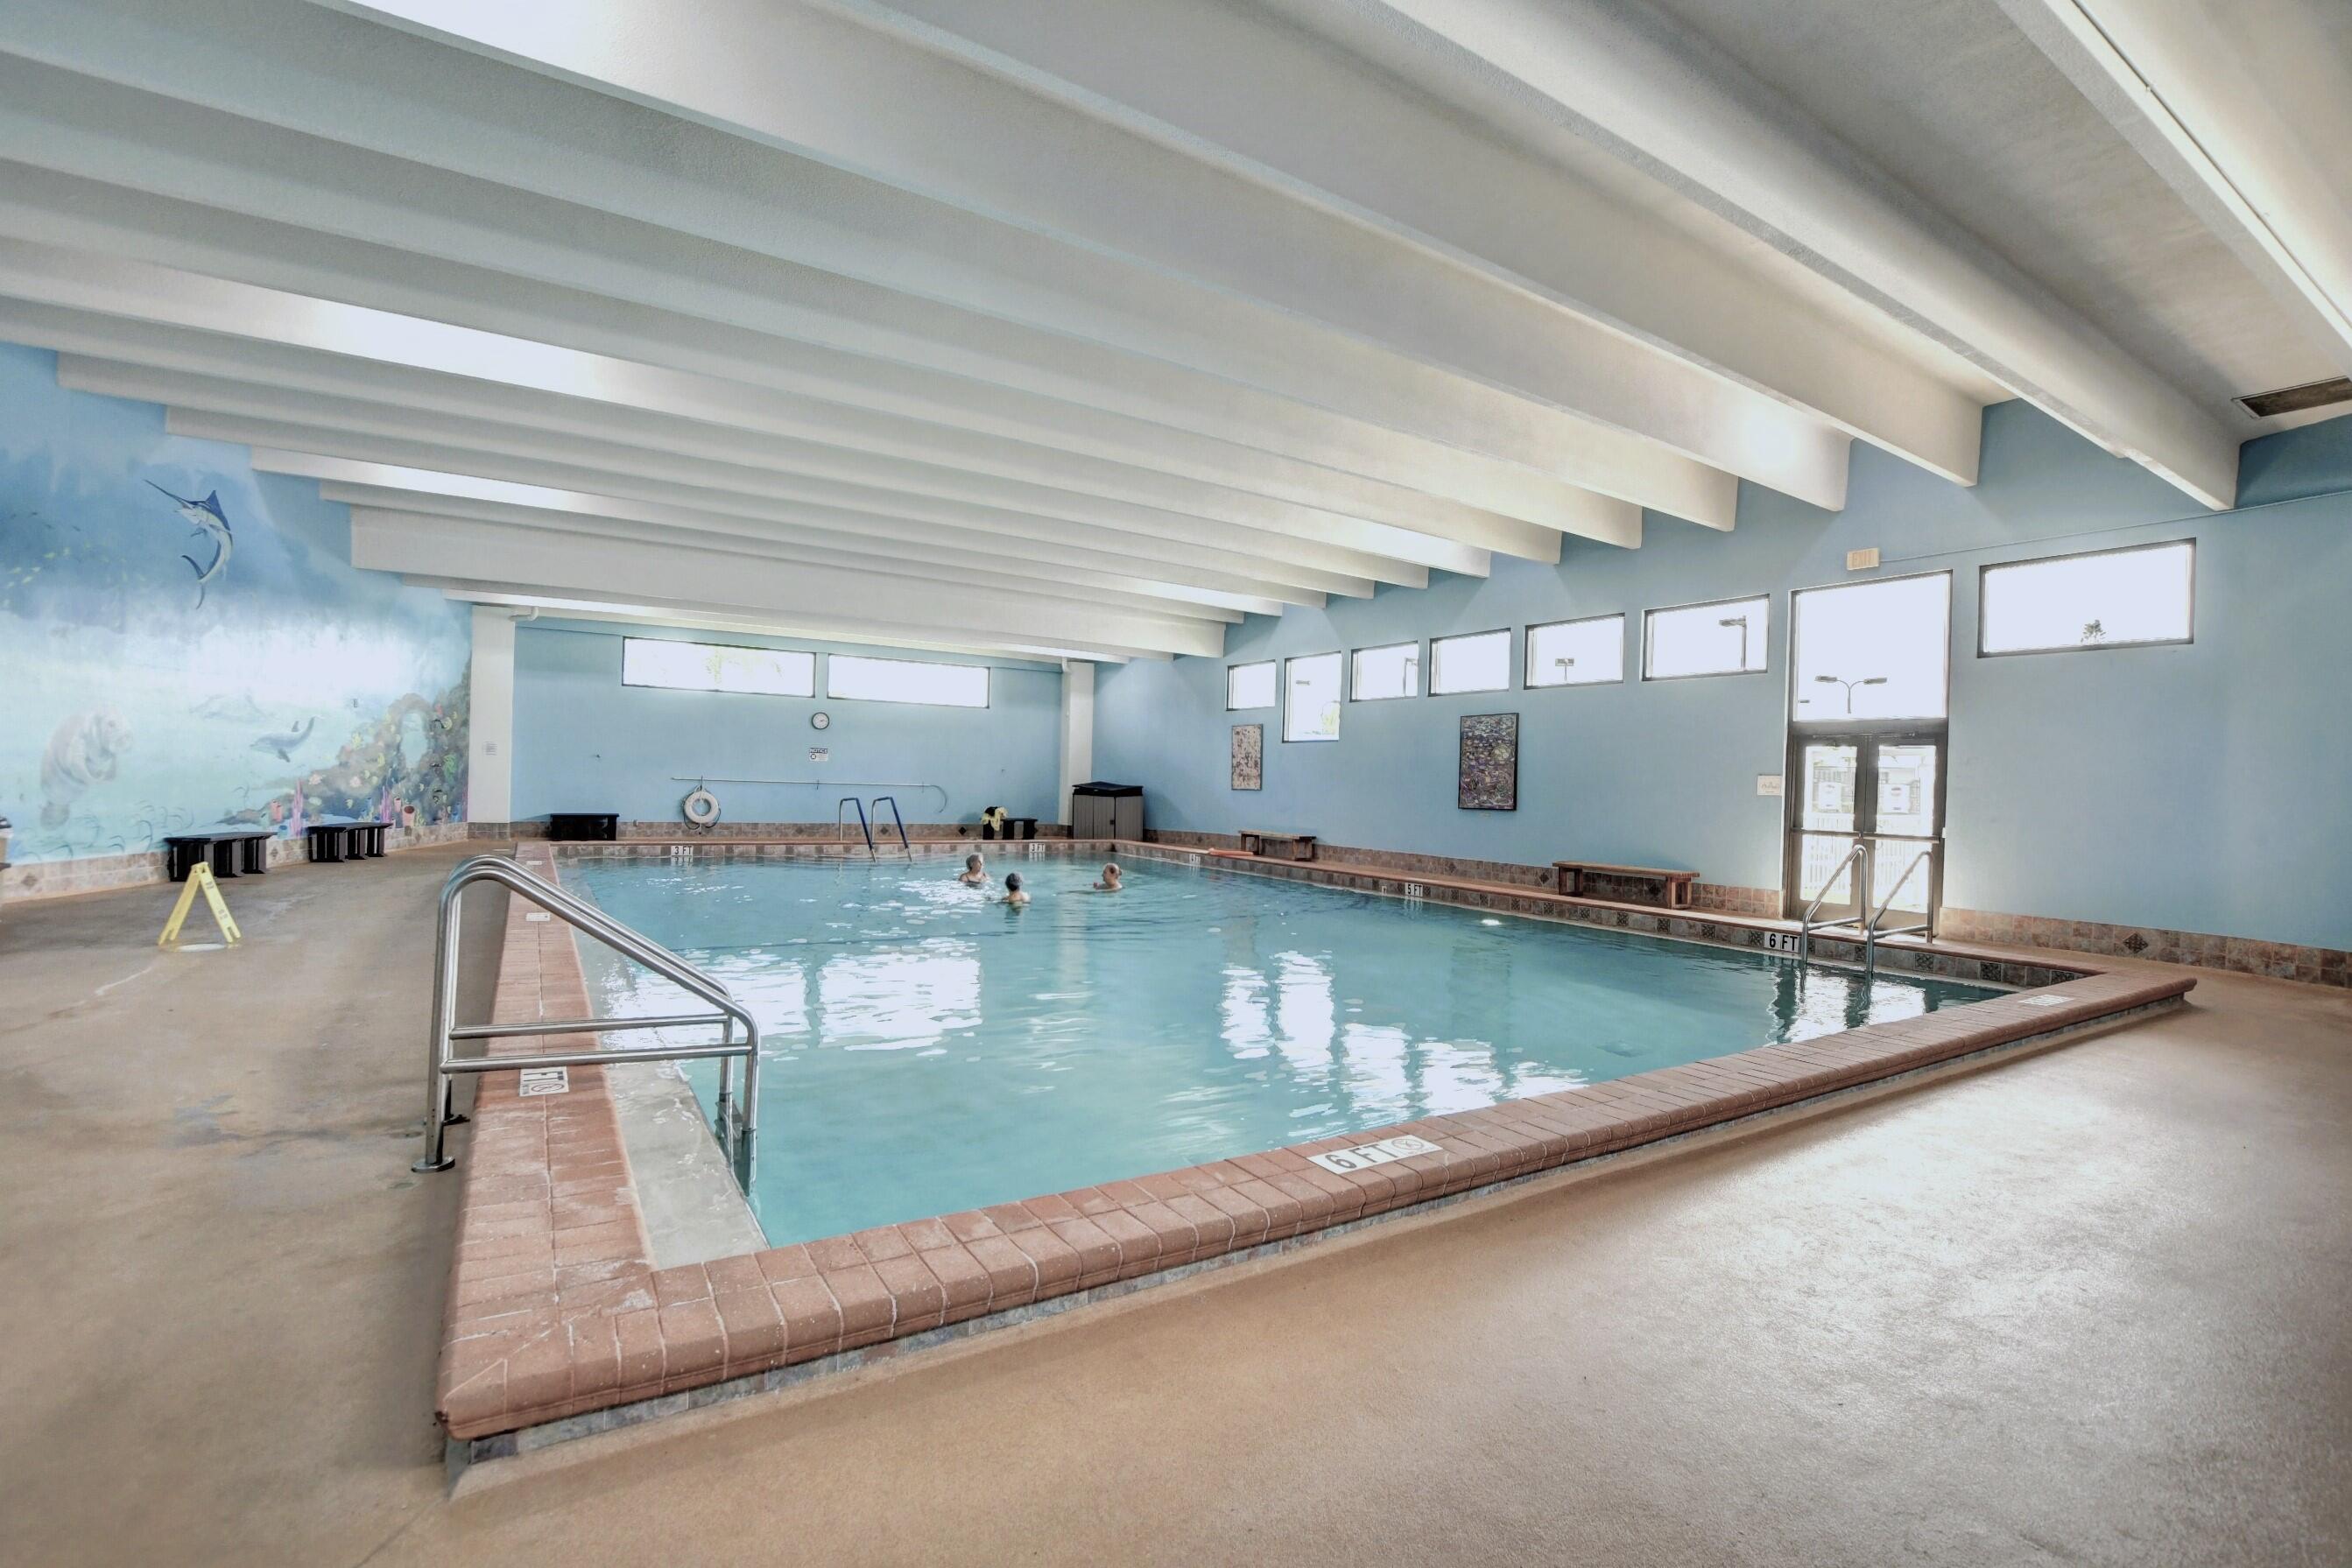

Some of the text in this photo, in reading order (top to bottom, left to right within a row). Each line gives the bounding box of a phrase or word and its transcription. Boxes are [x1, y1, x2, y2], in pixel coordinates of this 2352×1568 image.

[1852, 551, 1873, 567] EXIT
[674, 845, 692, 855] 3 FT
[1407, 883, 1422, 897] 5 FT
[1769, 933, 1798, 952] 6 FT
[1325, 1154, 1357, 1169] 6
[1349, 1143, 1398, 1164] FT
